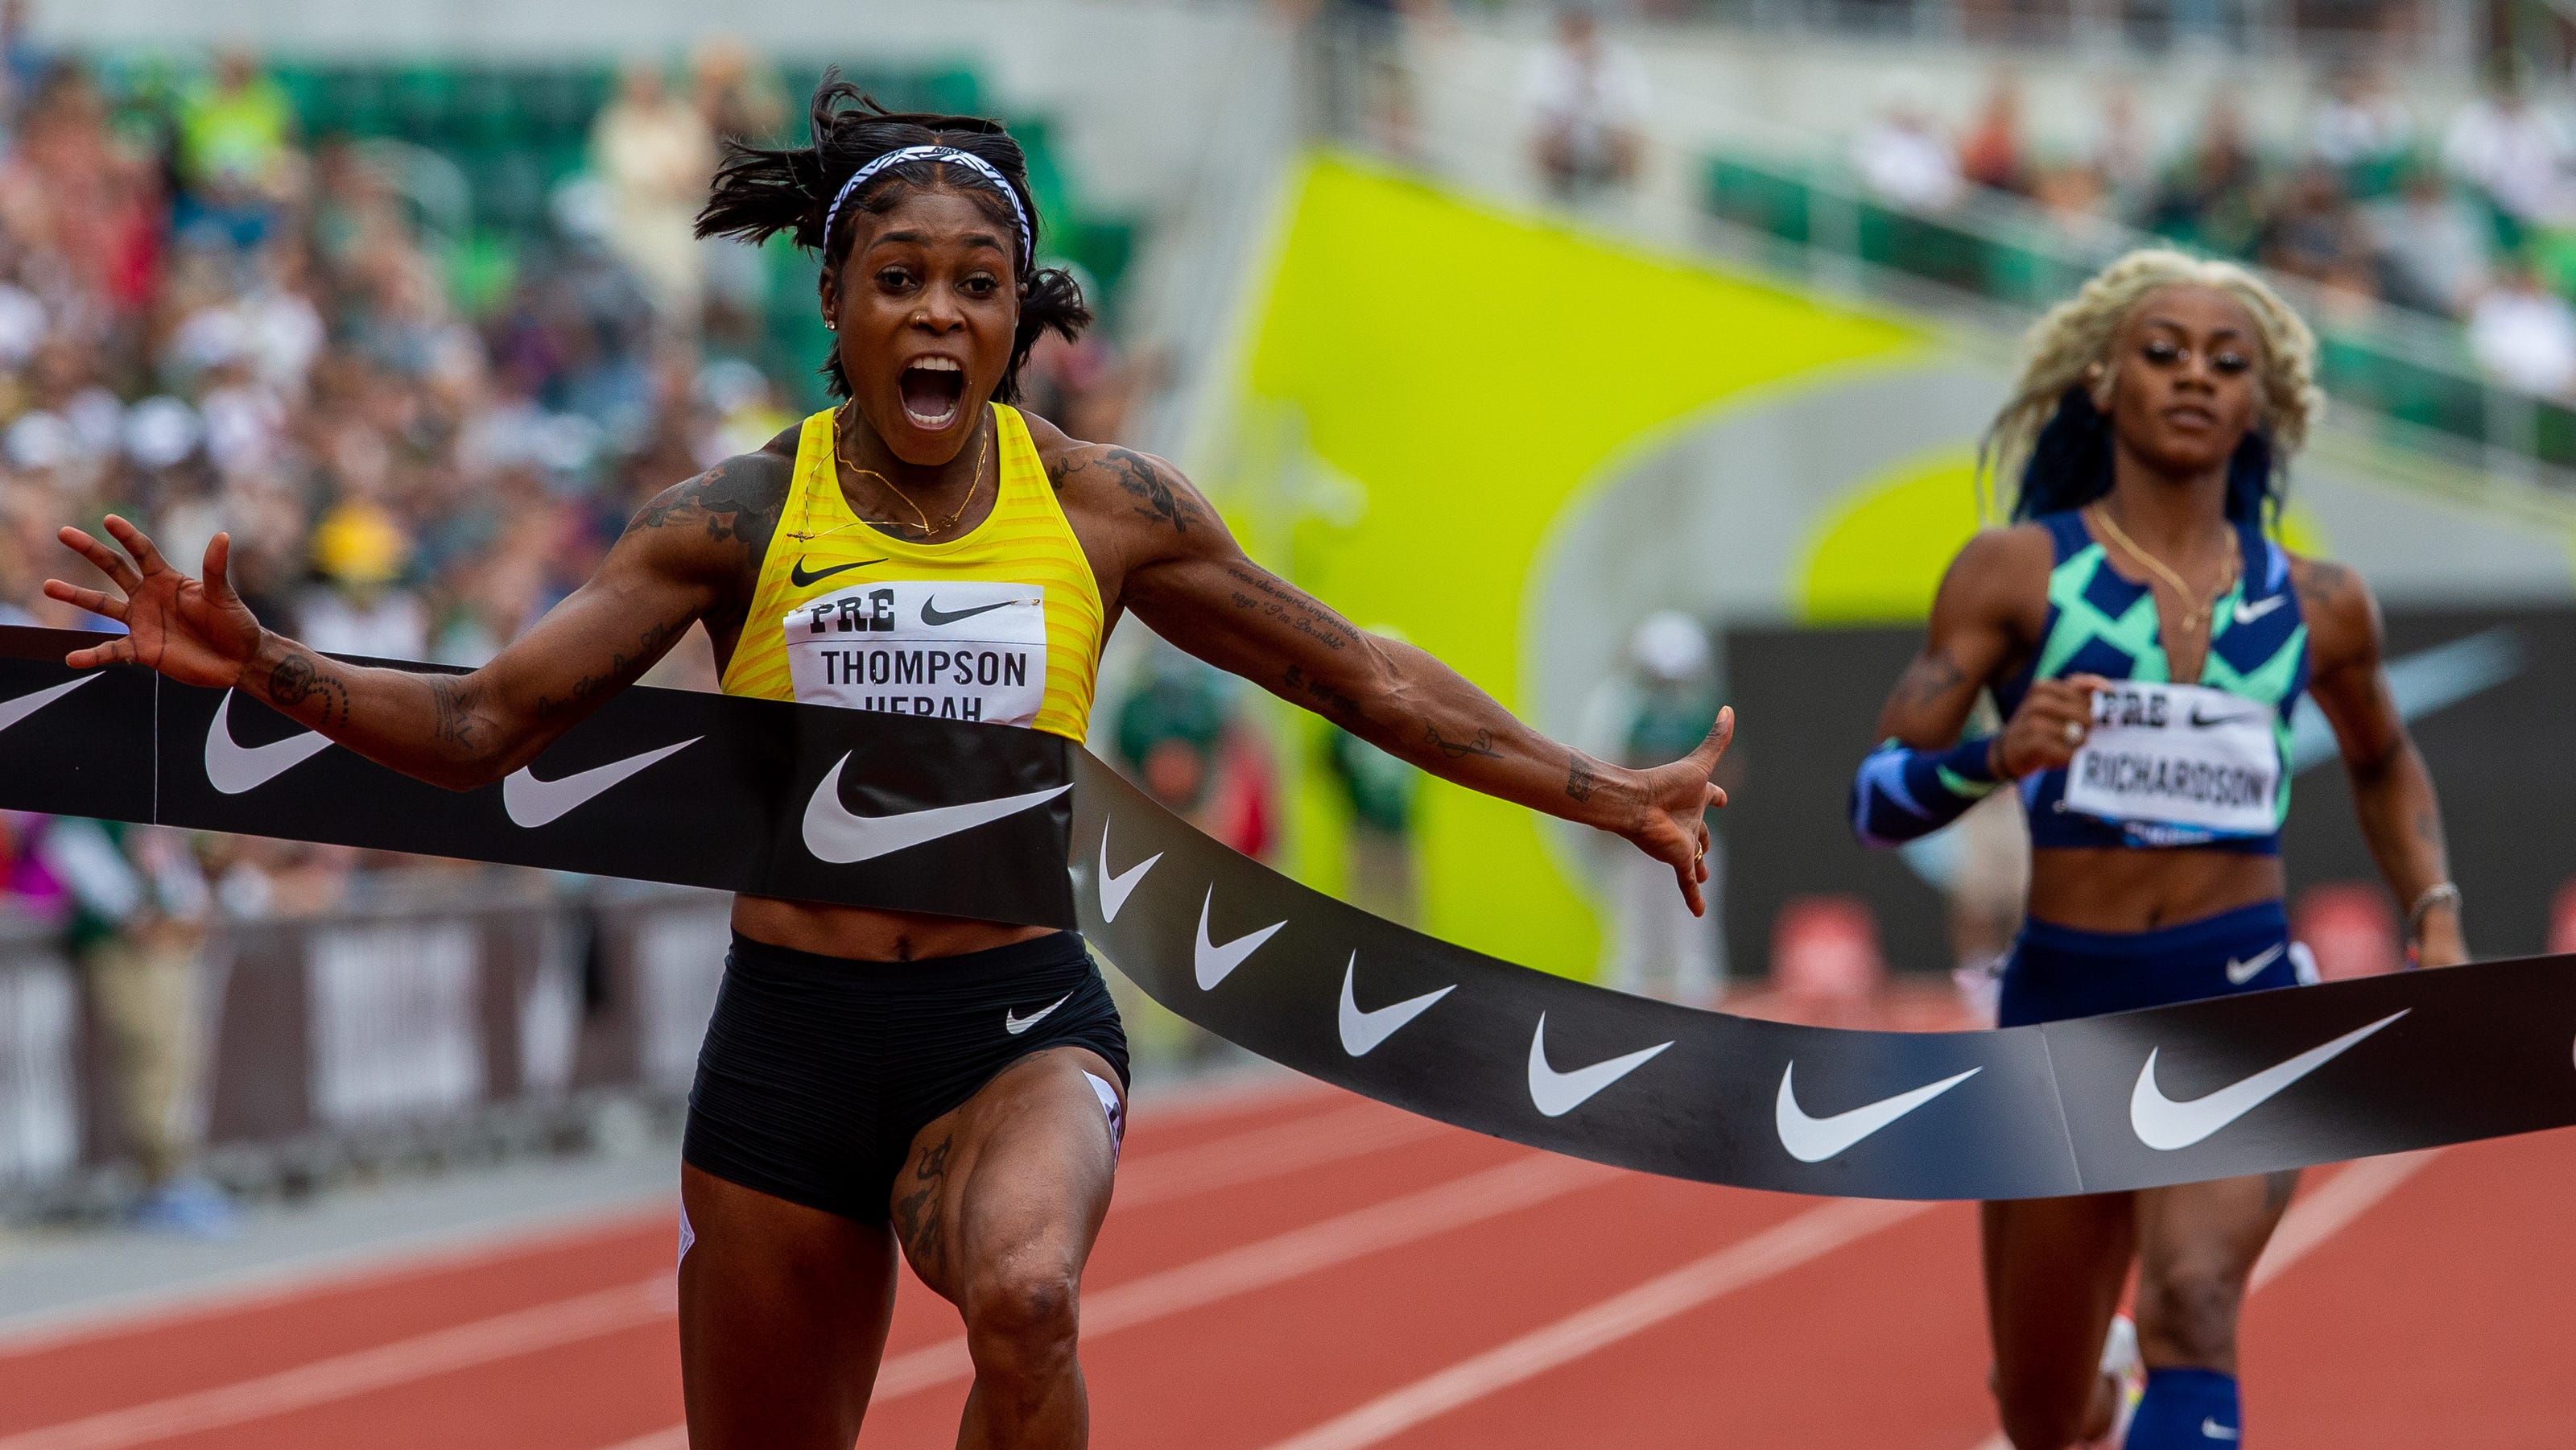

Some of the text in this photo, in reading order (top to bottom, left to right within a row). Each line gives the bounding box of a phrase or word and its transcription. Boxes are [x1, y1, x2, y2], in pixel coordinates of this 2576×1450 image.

[809, 589, 895, 634] PRE
[820, 651, 1027, 688] THOMPSON
[2096, 692, 2167, 728] PRE
[2083, 751, 2264, 807] RICHARDSON
